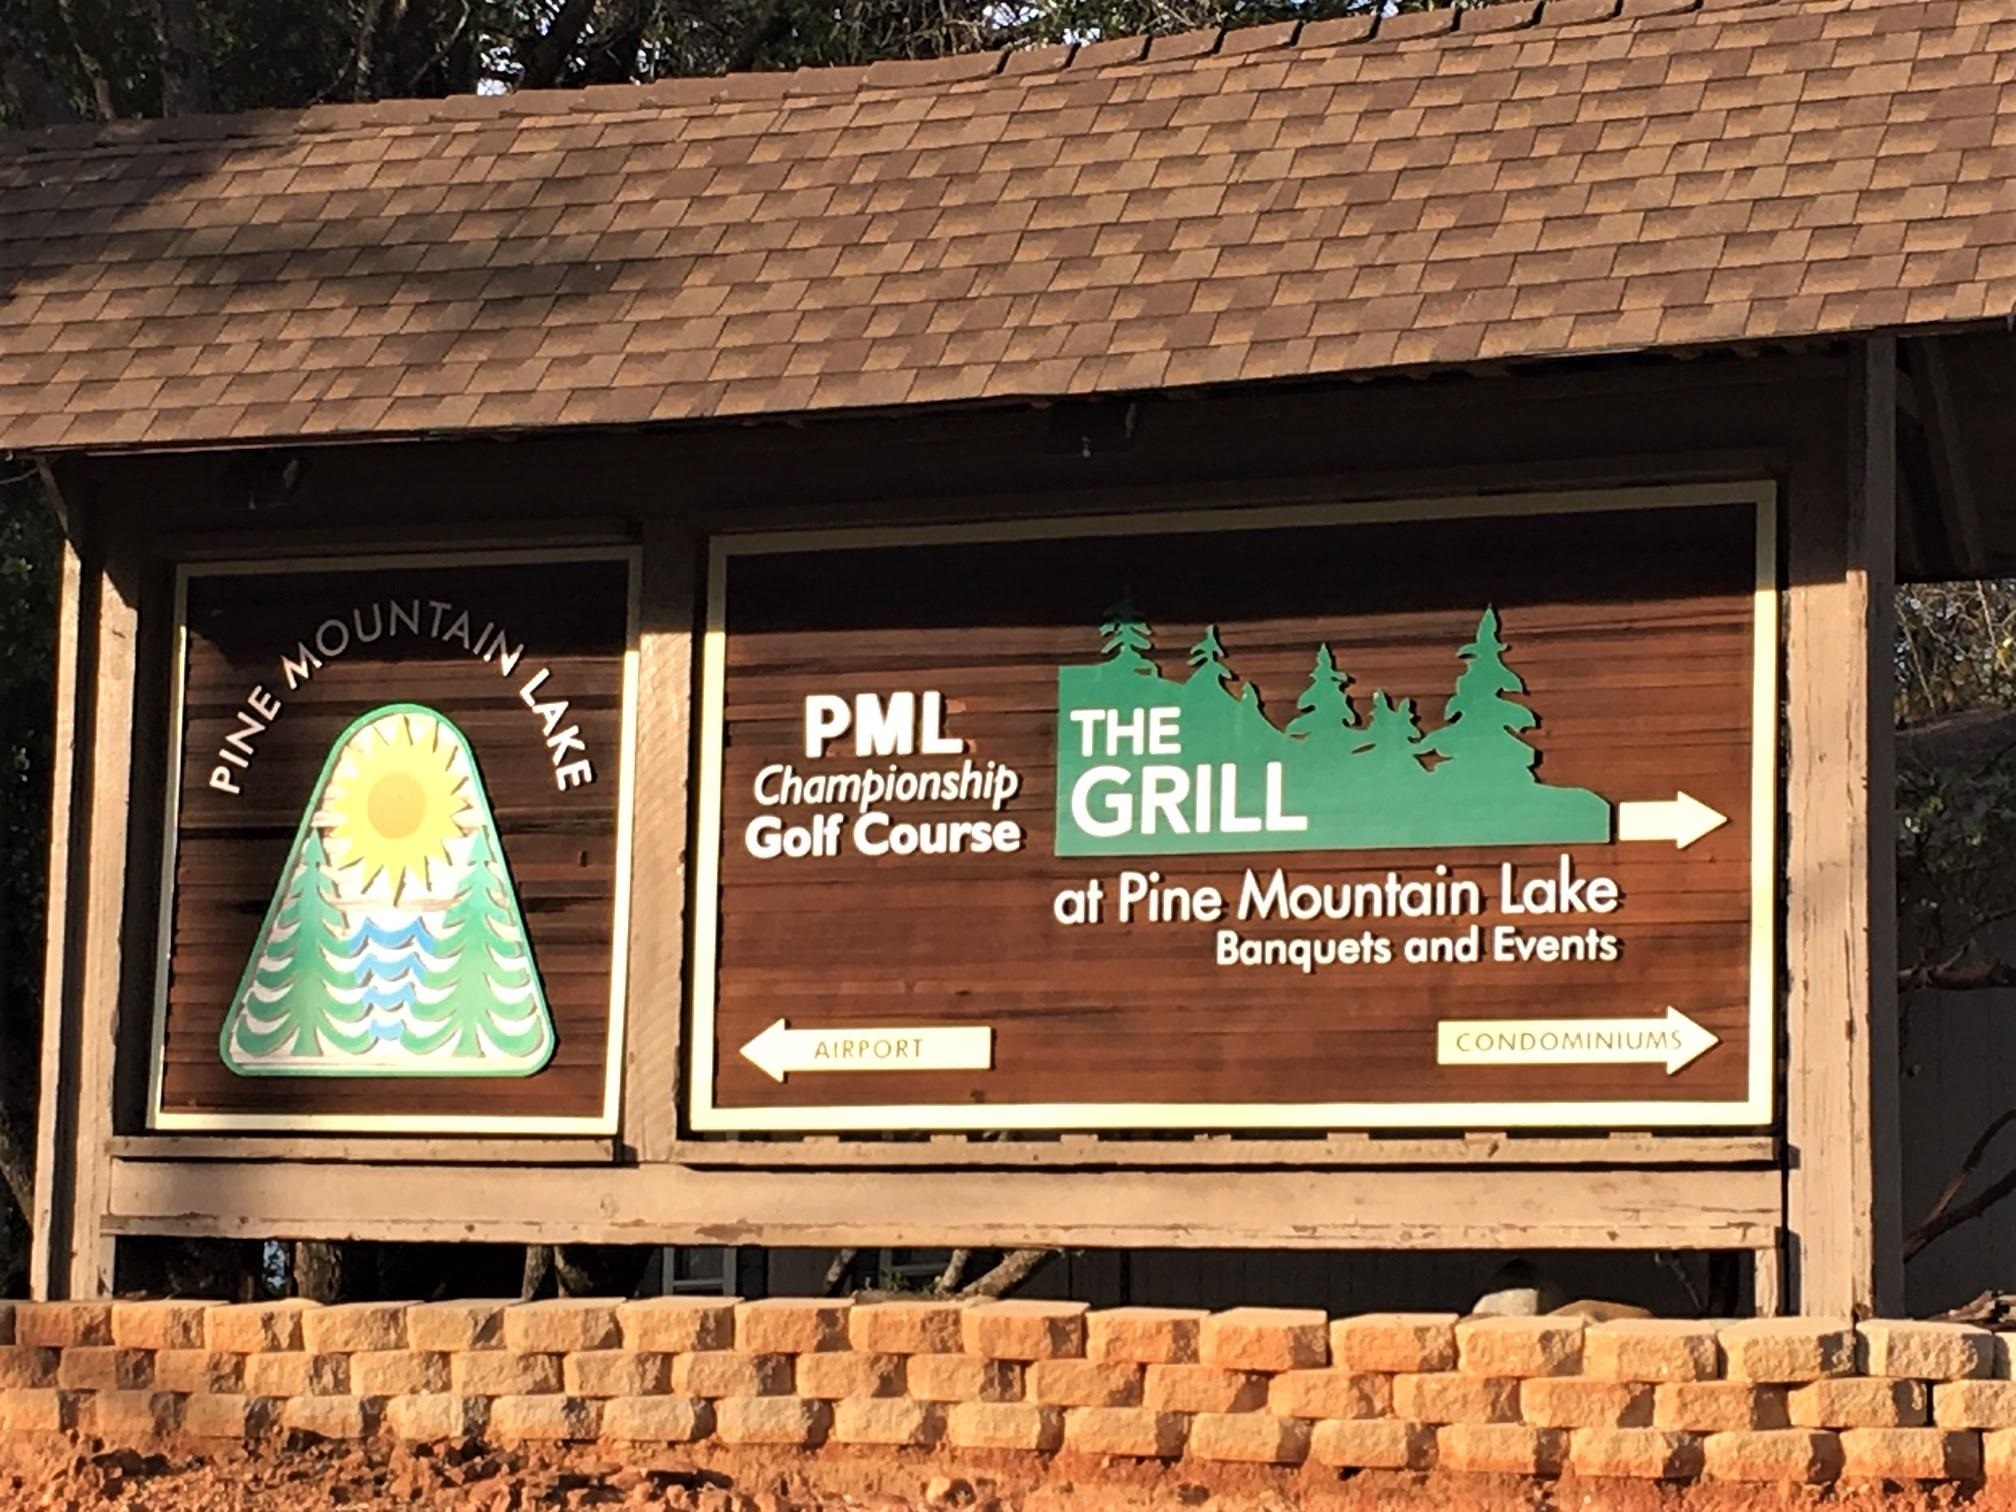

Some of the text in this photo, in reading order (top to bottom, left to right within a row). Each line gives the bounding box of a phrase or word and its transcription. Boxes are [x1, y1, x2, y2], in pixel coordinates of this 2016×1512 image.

[209, 600, 593, 795] PINE MOUNTAIN LAKE
[805, 691, 963, 758] PML
[1070, 706, 1182, 757] THE
[754, 760, 1019, 810] Championship
[1071, 762, 1308, 837] GRILL
[745, 813, 1021, 858] Golf Course
[1053, 854, 1619, 924] at Pine Mountain Lake
[1217, 925, 1619, 973] Banquets and Events
[813, 1037, 924, 1060] AIRPORT
[1455, 1031, 1683, 1053] CONDOMINIUMS
